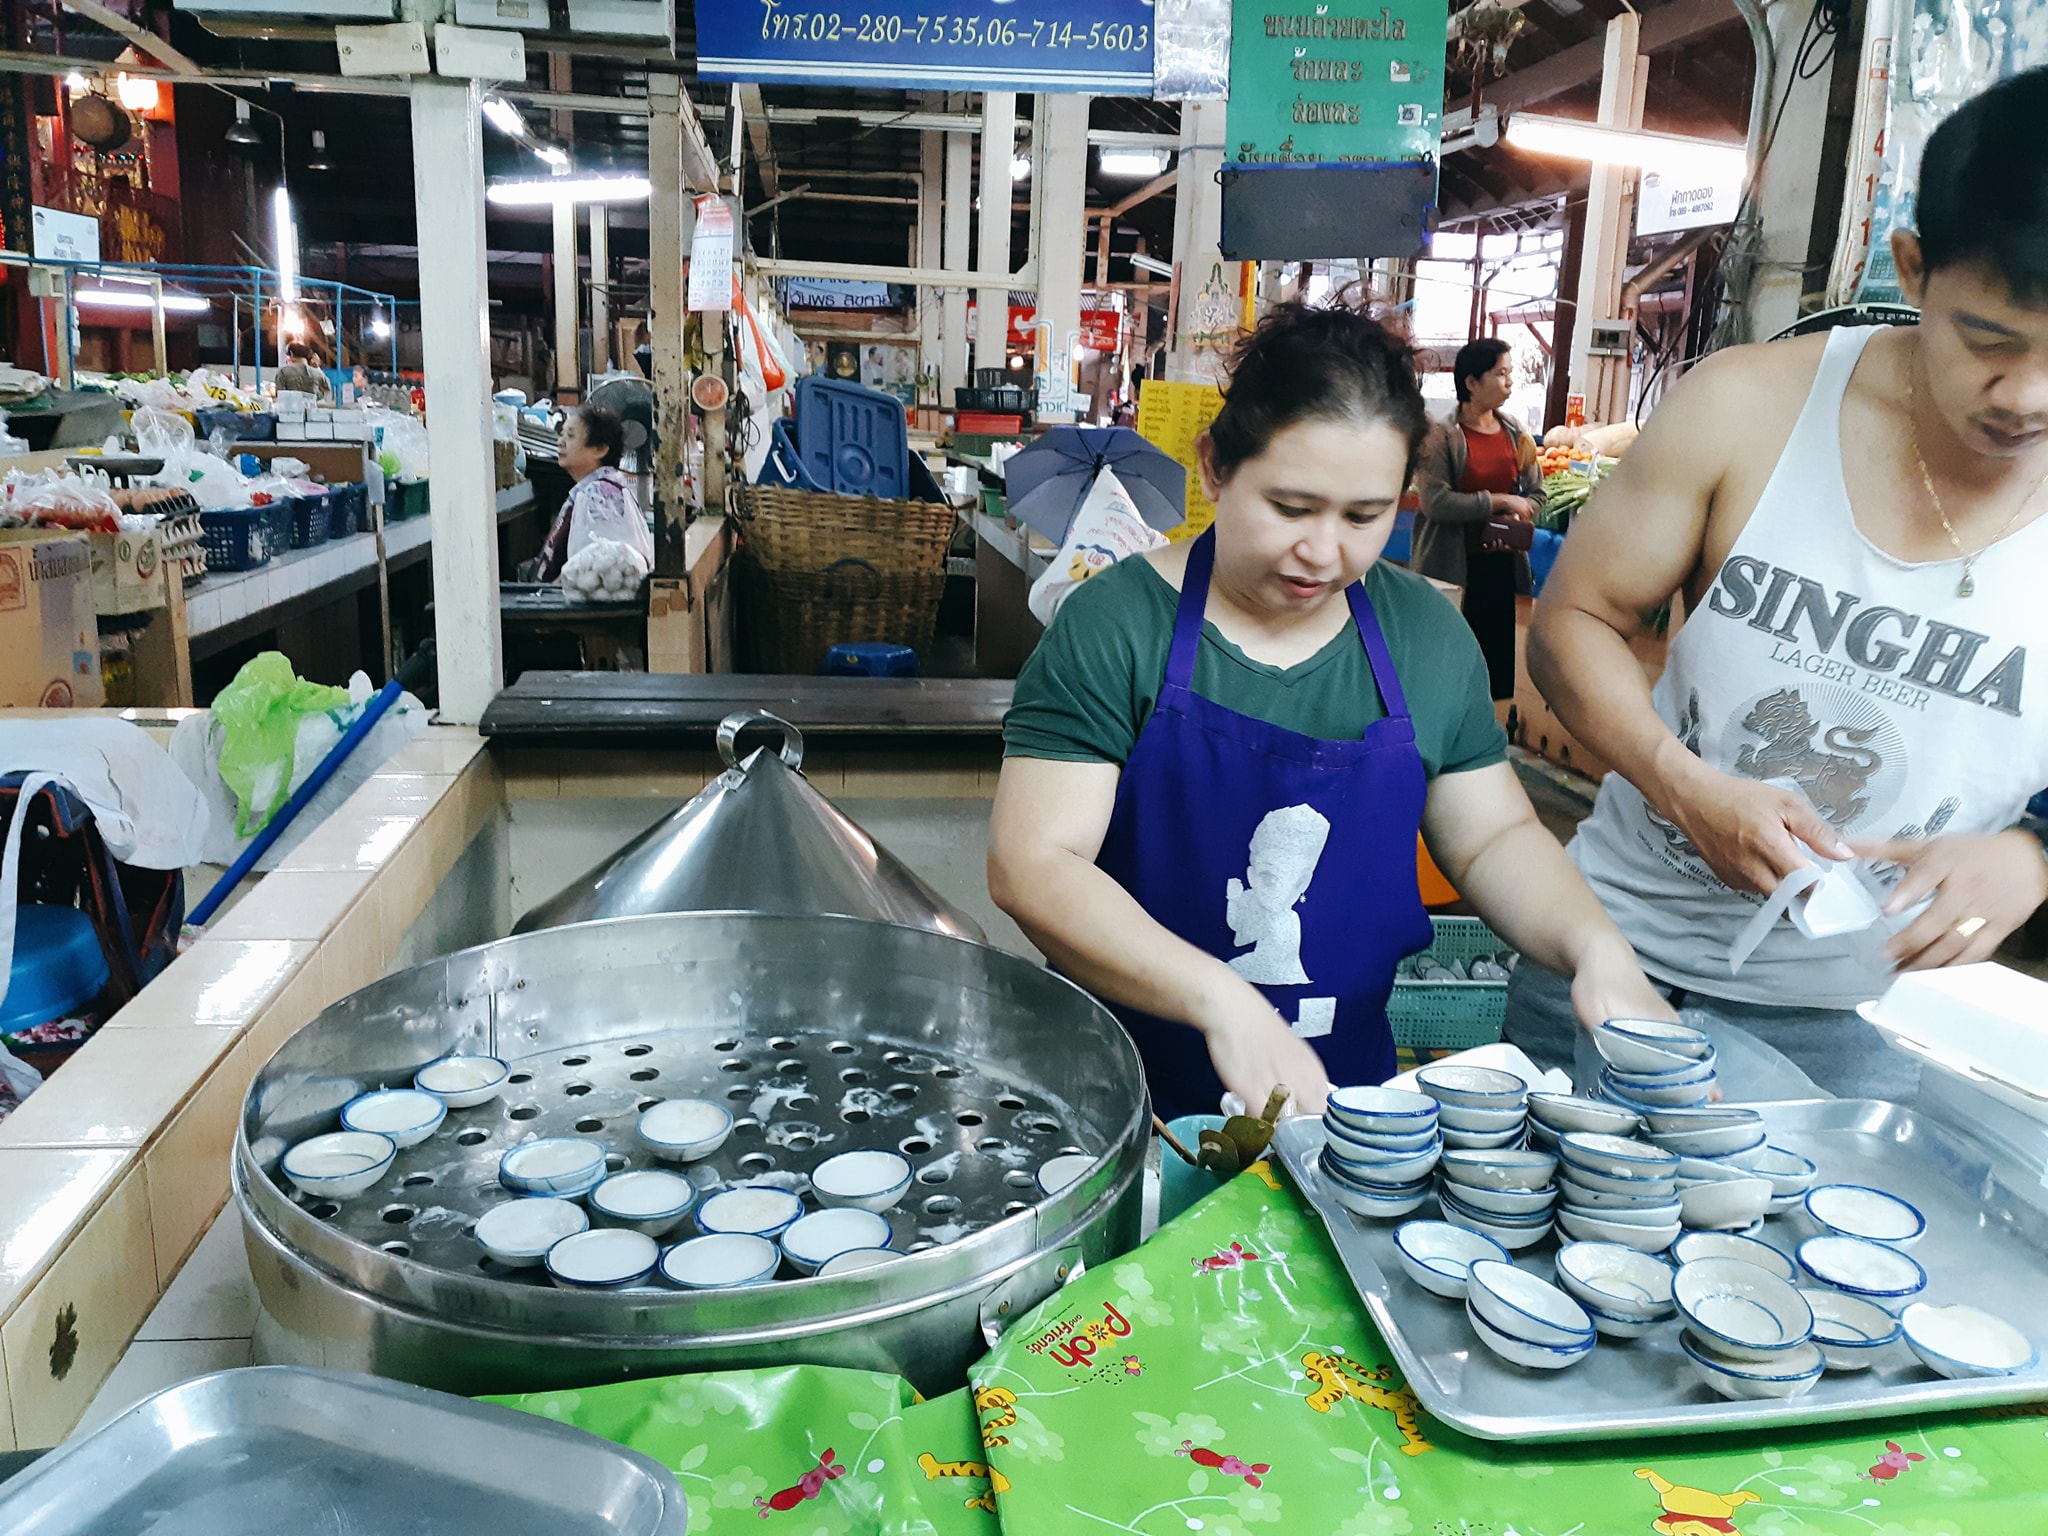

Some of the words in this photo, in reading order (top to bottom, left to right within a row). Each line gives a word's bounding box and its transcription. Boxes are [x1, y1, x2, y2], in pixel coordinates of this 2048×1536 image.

[1264, 4, 1407, 40] ขนมถ้วยตะไล
[1290, 47, 1363, 82] ร้อยละ
[1708, 554, 2028, 719] SINGHA
[1769, 641, 1856, 686] LAGER
[1861, 673, 1932, 713] BEER
